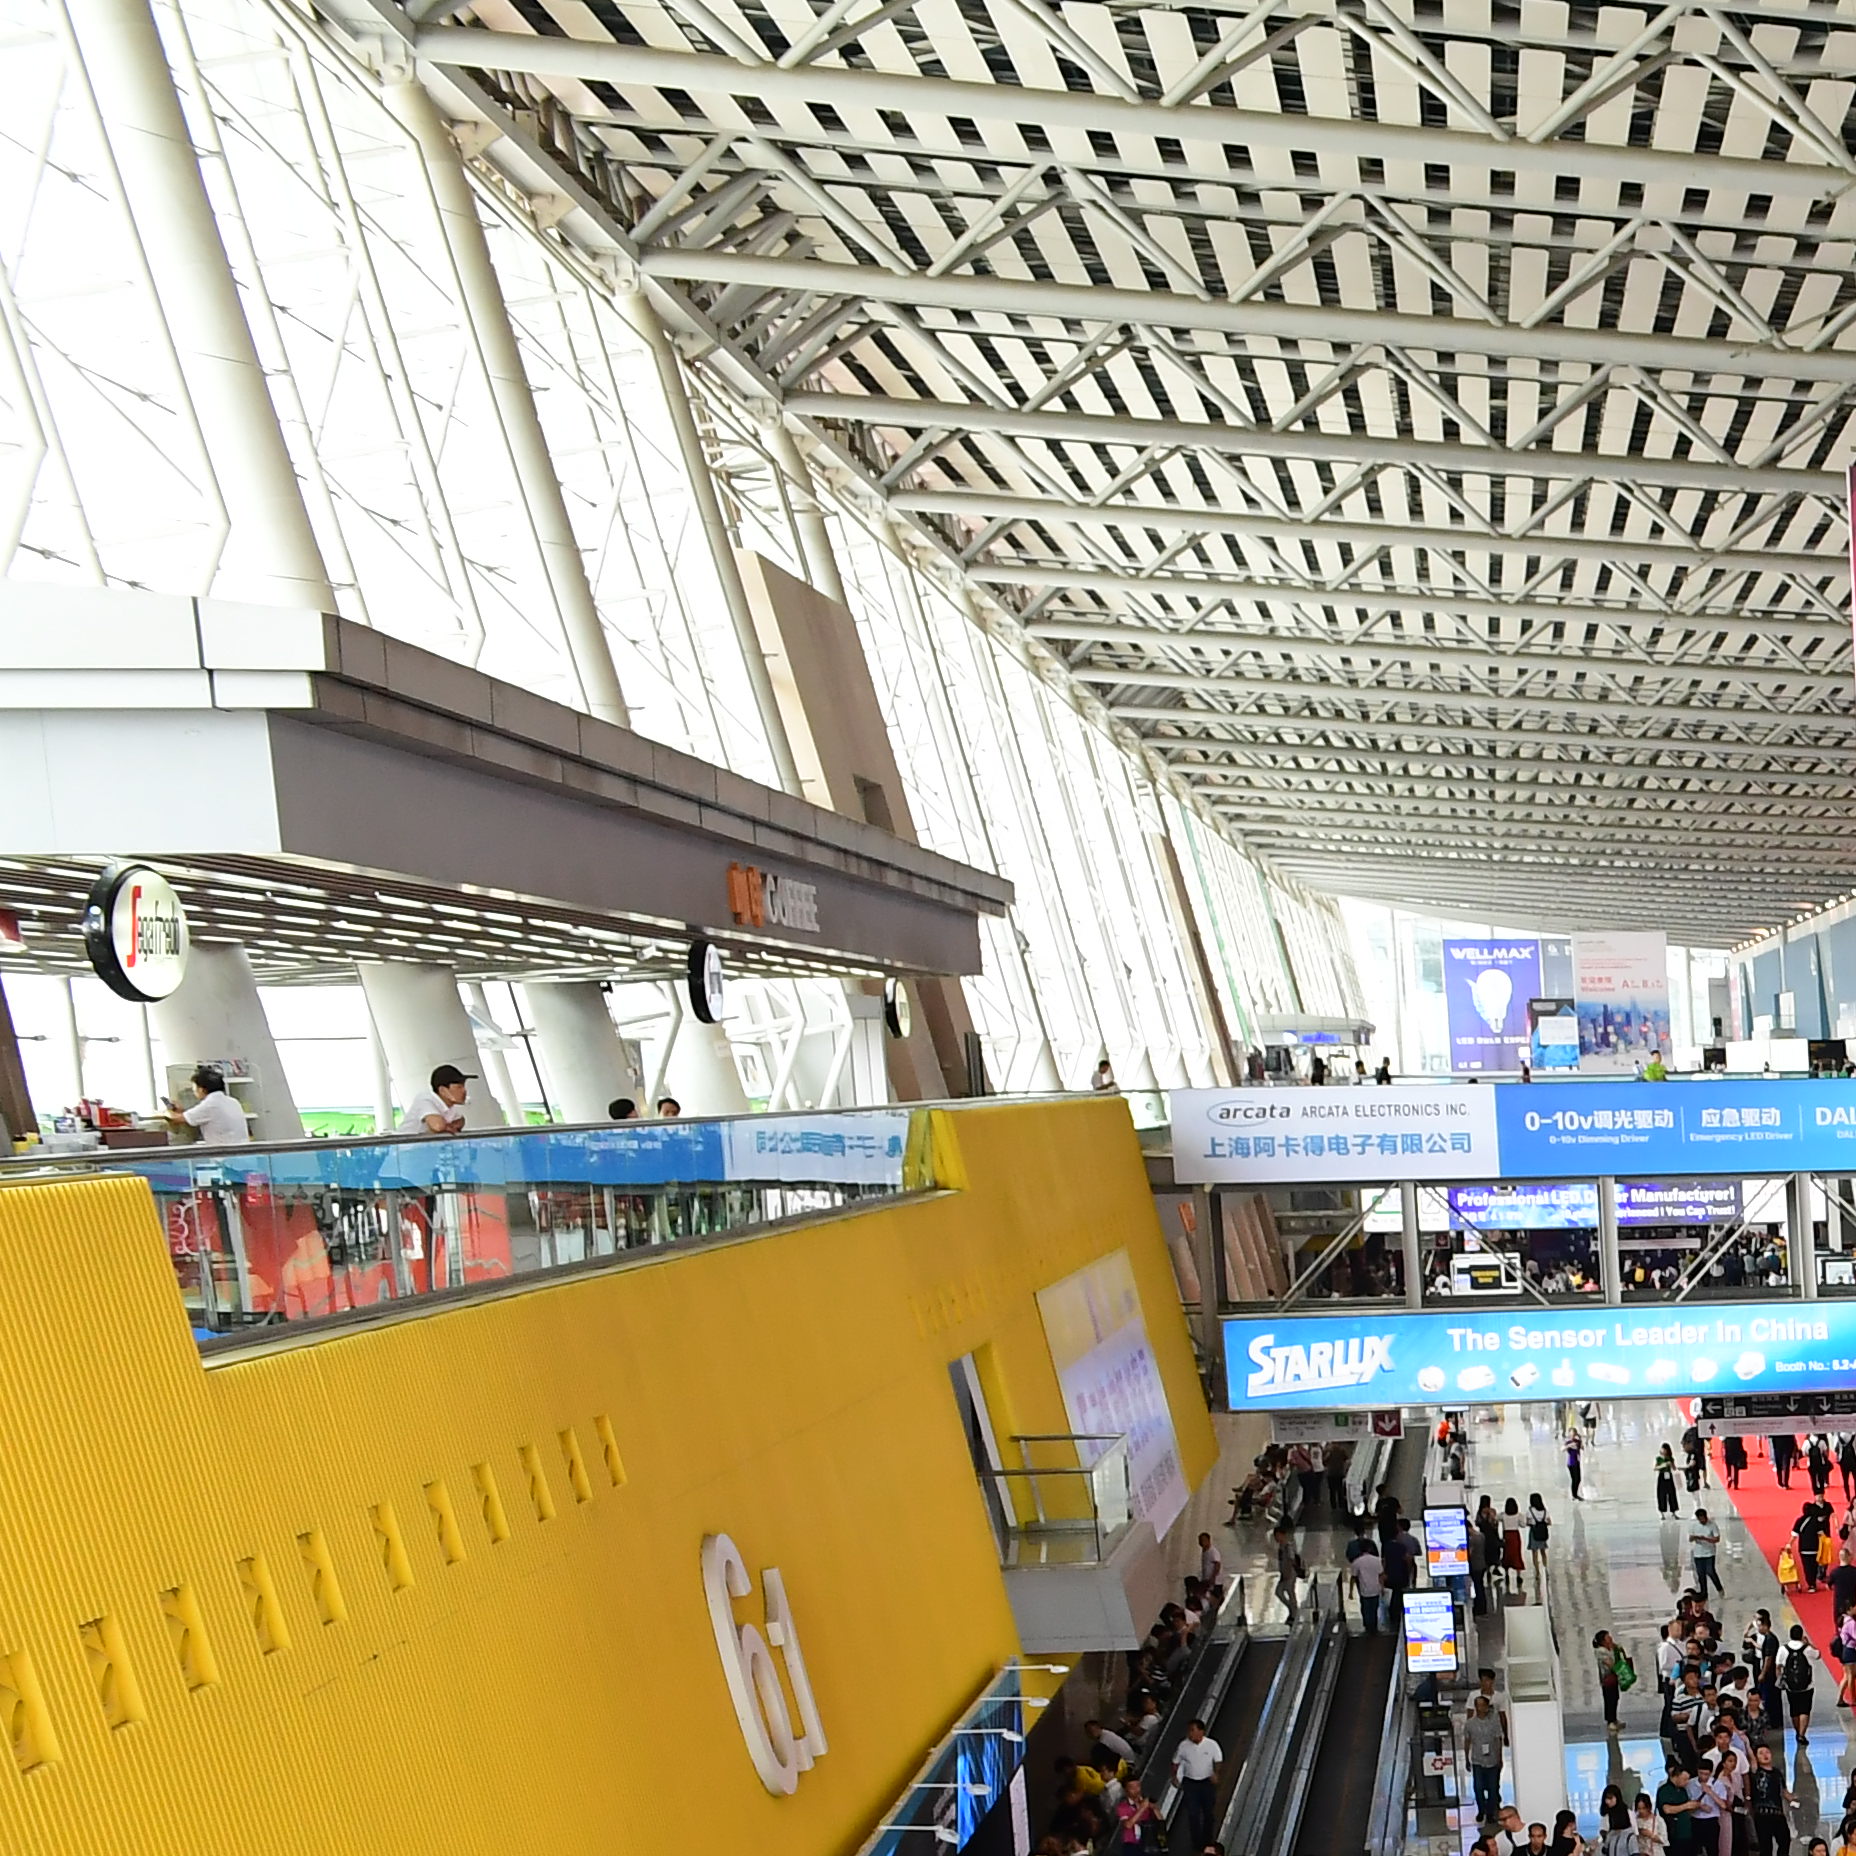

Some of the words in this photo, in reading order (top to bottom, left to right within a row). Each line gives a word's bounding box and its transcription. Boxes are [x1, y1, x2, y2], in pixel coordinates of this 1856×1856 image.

[1450, 946, 1533, 960] WELLMAX
[1218, 1103, 1292, 1121] arcata
[1301, 1105, 1349, 1118] ARCATA
[1355, 1103, 1441, 1118] ELECTRONICS
[1445, 1102, 1471, 1117] INC.
[1700, 1107, 1781, 1129] 应急驱动
[1203, 1132, 1473, 1161] 上海阿卡得电子有限公司
[1577, 1134, 1620, 1145] Dimming
[1621, 1133, 1650, 1143] Driver
[1689, 1132, 1743, 1143] Emergency
[1744, 1131, 1764, 1141] LED
[1765, 1131, 1794, 1141] Driver
[1446, 1328, 1501, 1352] The
[1508, 1325, 1607, 1350] Sensor
[1614, 1321, 1709, 1347] Leader
[1749, 1317, 1830, 1343] China
[1247, 1332, 1397, 1390] STARLUX
[1775, 1360, 1807, 1373] Booth
